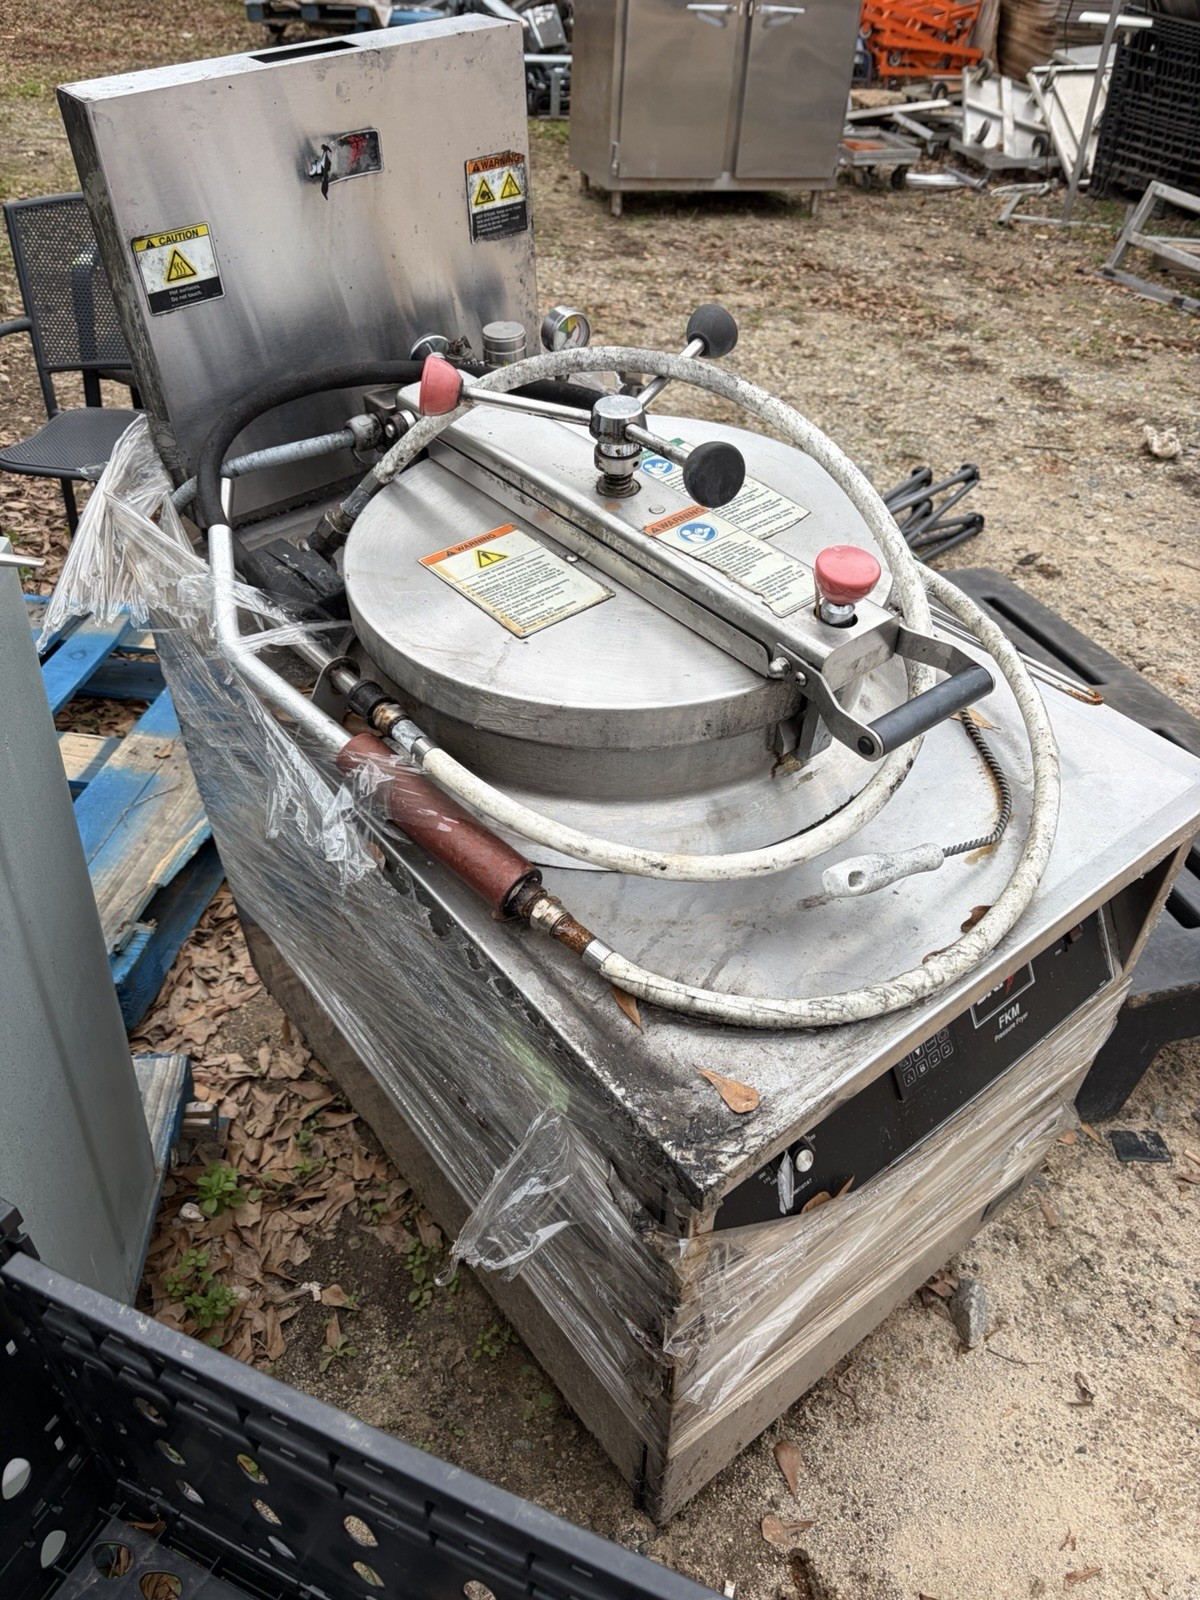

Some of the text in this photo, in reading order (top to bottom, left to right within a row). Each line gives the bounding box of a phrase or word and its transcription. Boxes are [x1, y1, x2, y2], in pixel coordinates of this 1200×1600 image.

[481, 153, 521, 169] WARNING
[158, 229, 199, 245] CAUTION
[659, 506, 705, 529] WARNING
[456, 533, 496, 552] WARNING
[998, 1003, 1021, 1029] FKM
[994, 1011, 1029, 1042] Pressure Fryer
[919, 1064, 926, 1073] B
